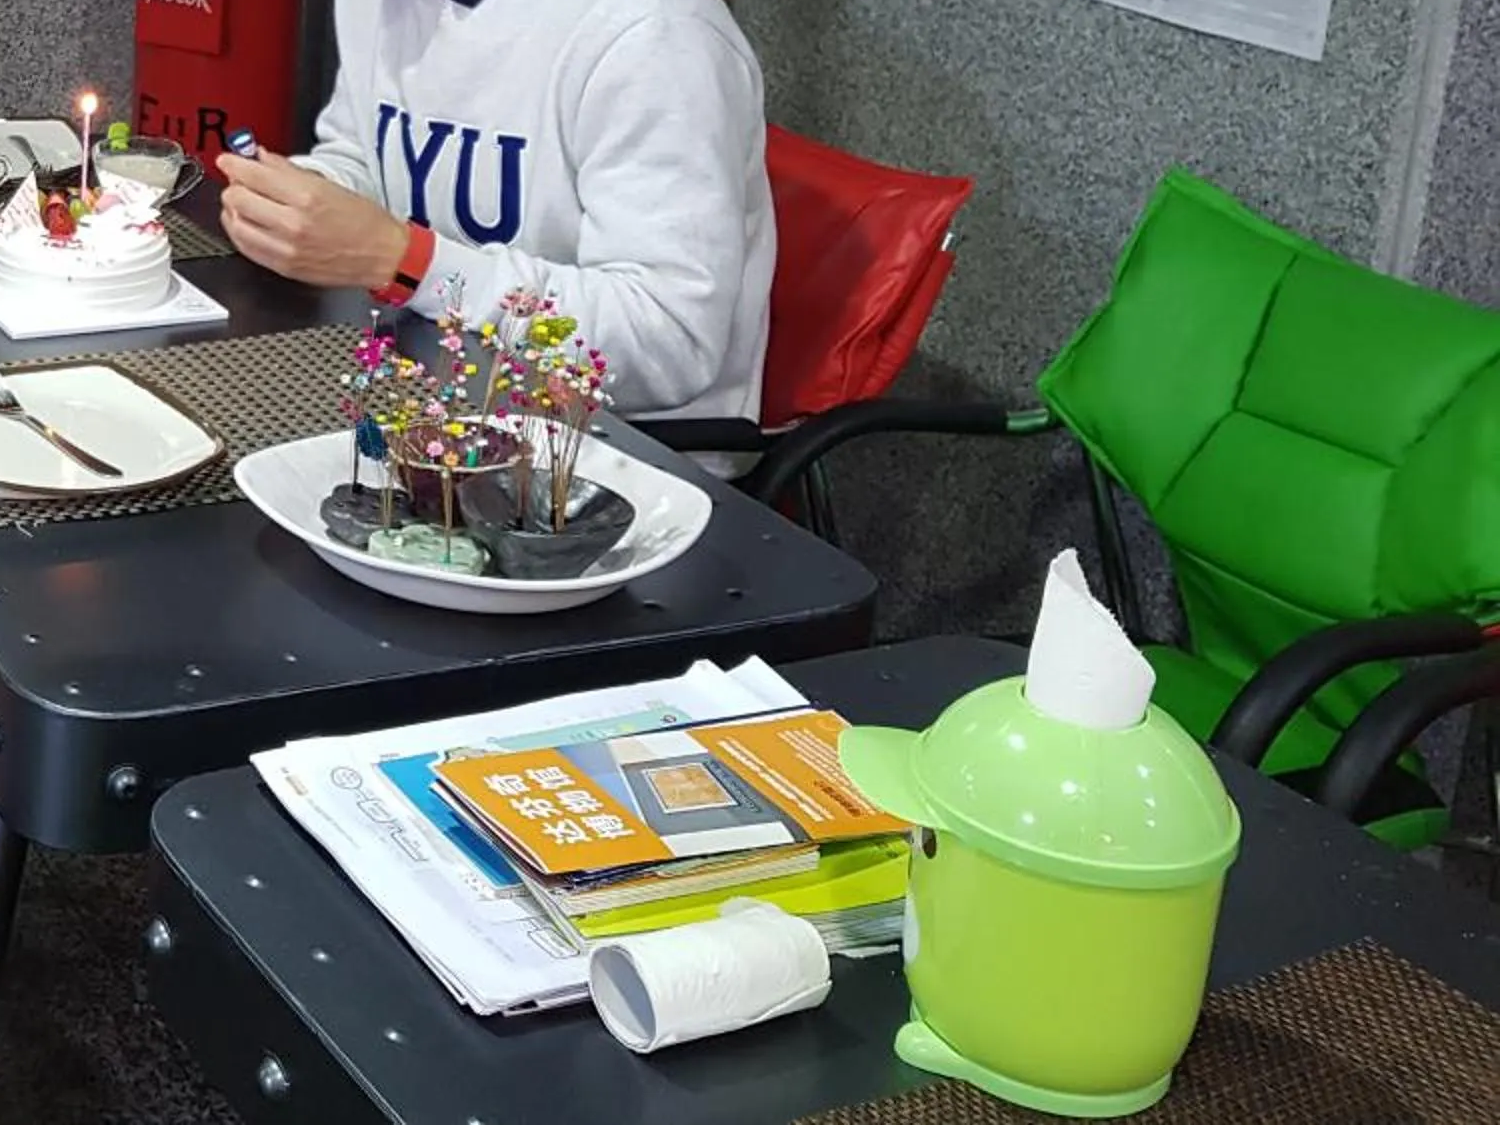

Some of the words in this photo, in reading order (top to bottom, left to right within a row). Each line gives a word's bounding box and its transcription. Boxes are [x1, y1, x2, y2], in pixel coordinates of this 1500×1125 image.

[484, 773, 592, 845] 达芬奇
[524, 765, 637, 840] 博物馆
